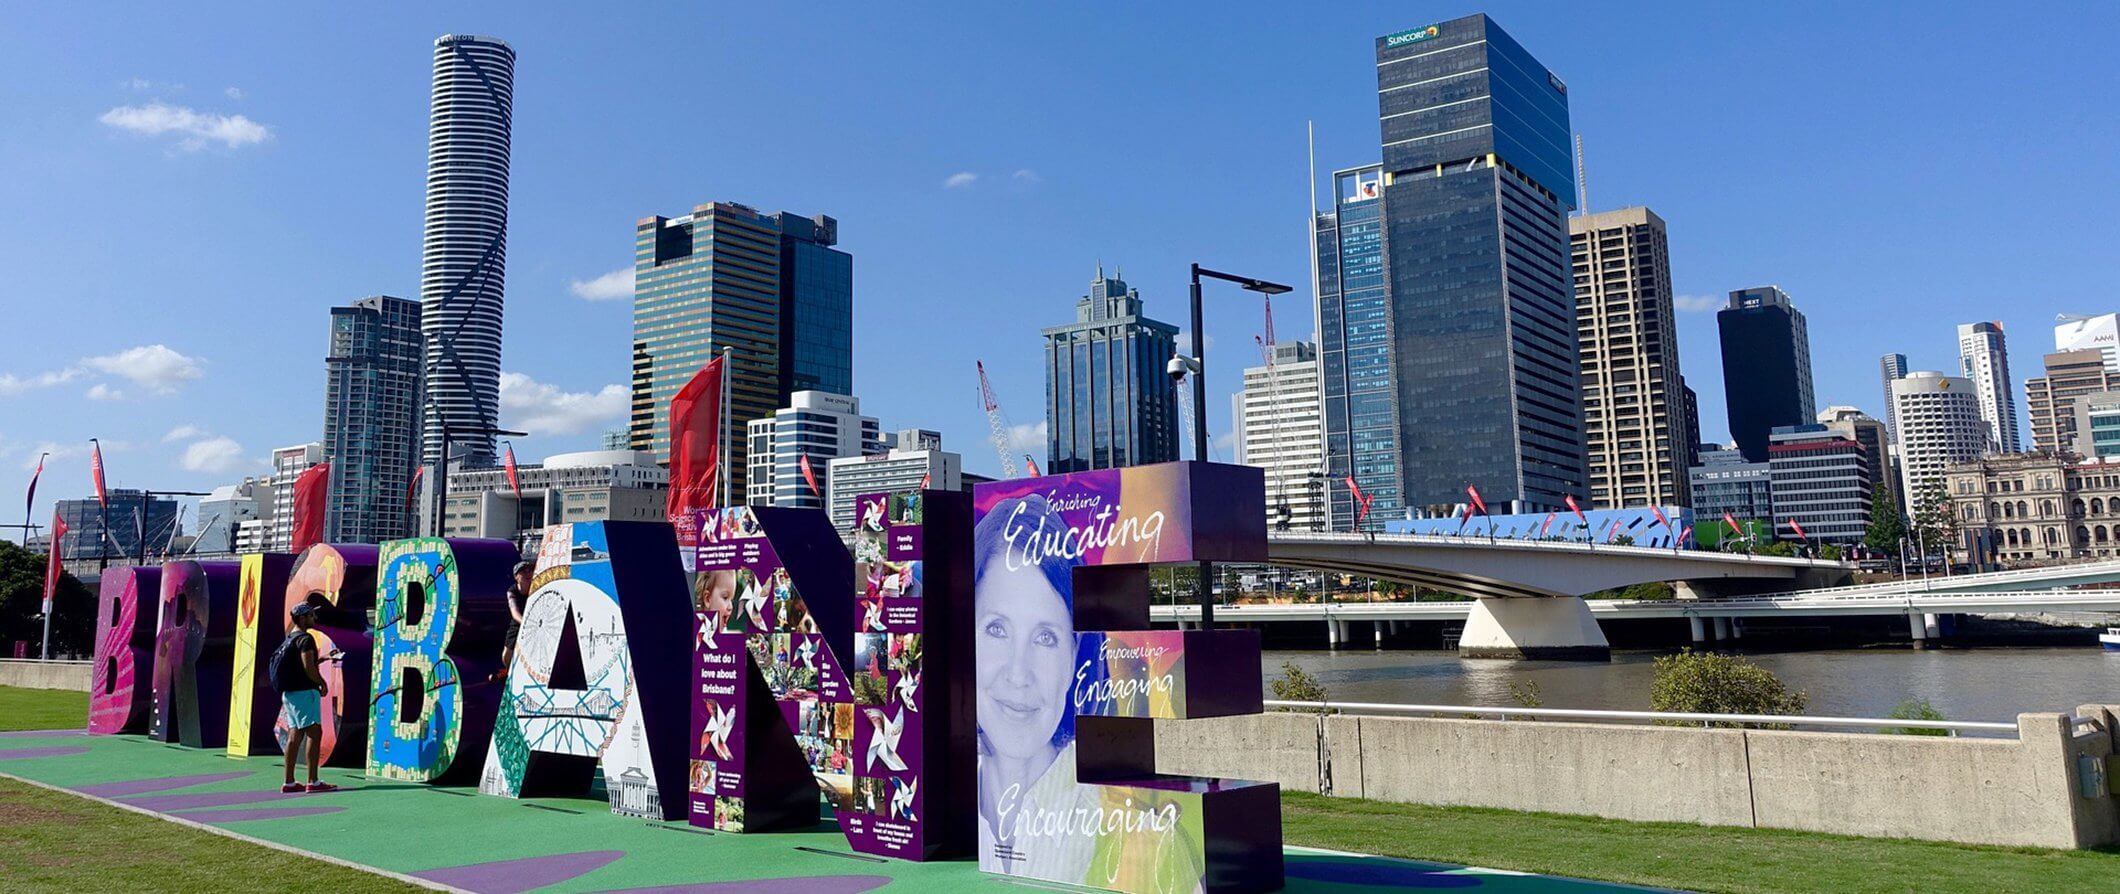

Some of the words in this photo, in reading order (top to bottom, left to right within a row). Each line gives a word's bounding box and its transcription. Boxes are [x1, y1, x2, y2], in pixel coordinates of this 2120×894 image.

[1388, 30, 1425, 46] SUNCORP
[1046, 489, 1101, 525] Enriching
[1003, 501, 1165, 571] Educating
[703, 653, 721, 663] What
[722, 653, 731, 663] do
[732, 654, 736, 664] I
[1099, 637, 1170, 669] Empowering
[701, 668, 715, 678] love
[716, 669, 737, 679] about
[702, 684, 735, 695] Brisbane?
[1074, 660, 1173, 717] Engaging
[998, 783, 1181, 888] Encouraging
